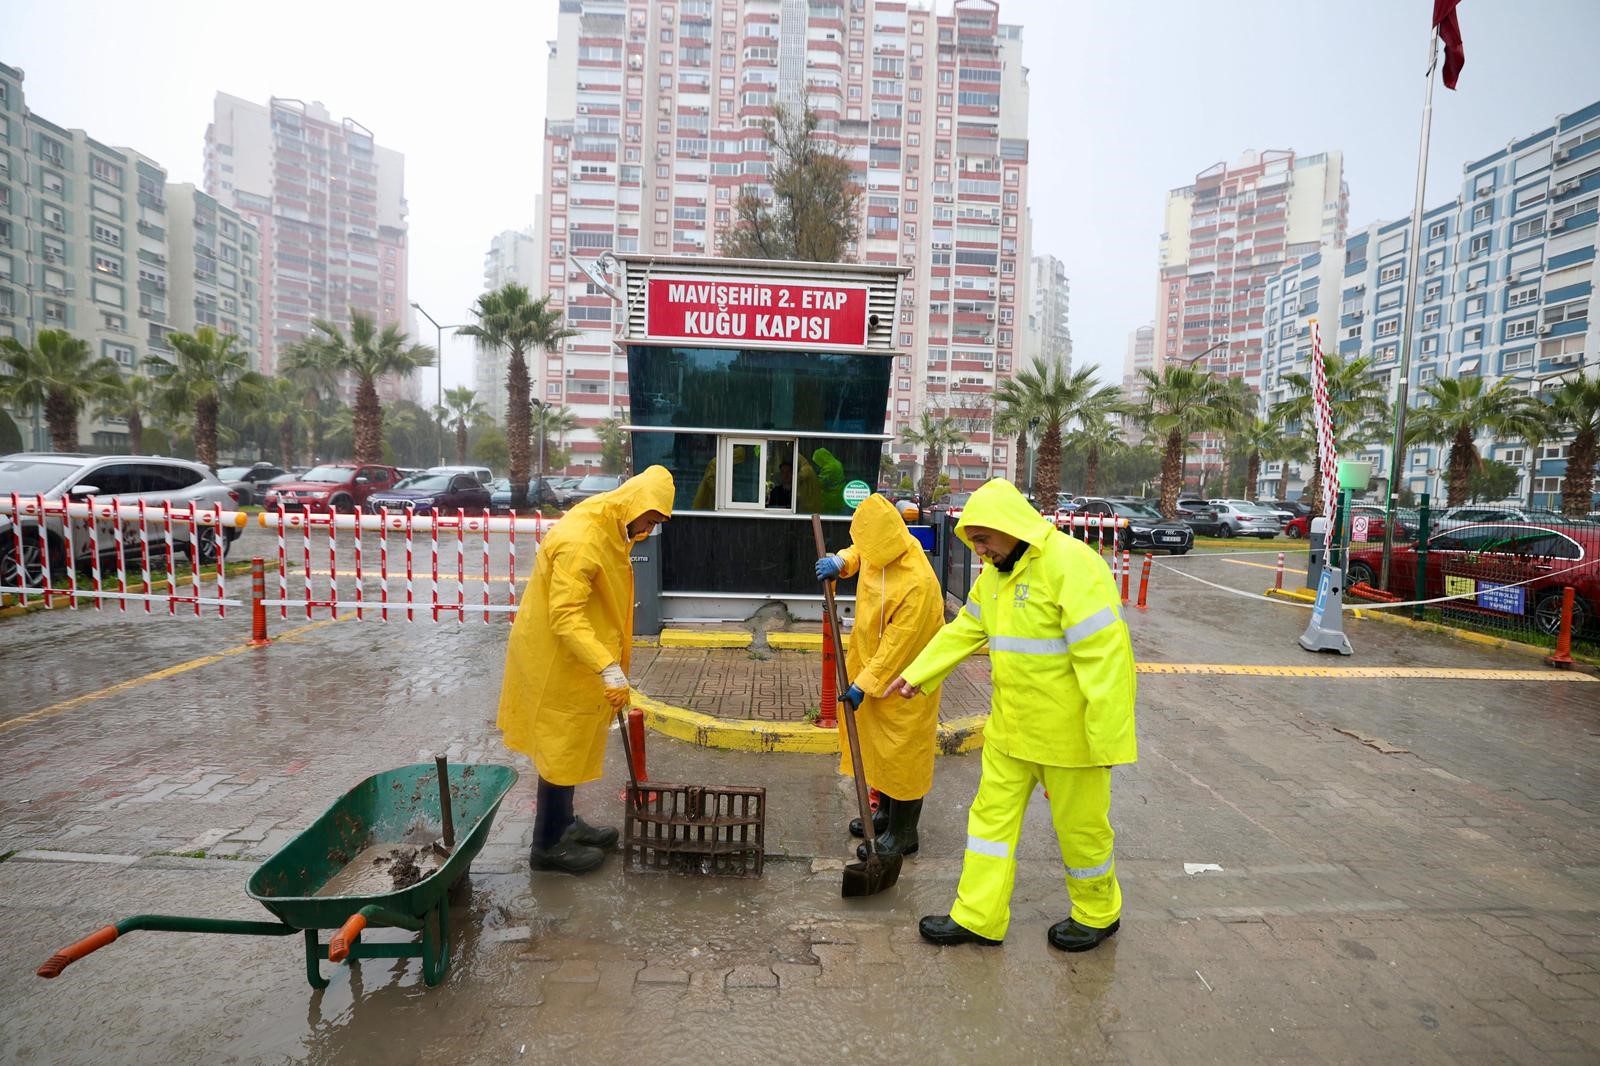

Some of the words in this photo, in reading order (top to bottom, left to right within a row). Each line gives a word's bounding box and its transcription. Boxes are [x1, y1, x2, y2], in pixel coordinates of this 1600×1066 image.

[668, 283, 772, 307] MAVİŞEHİR
[778, 289, 796, 308] 2.
[802, 290, 847, 310] ETAP
[685, 307, 746, 336] KUĞU
[755, 314, 831, 340] KAPISI
